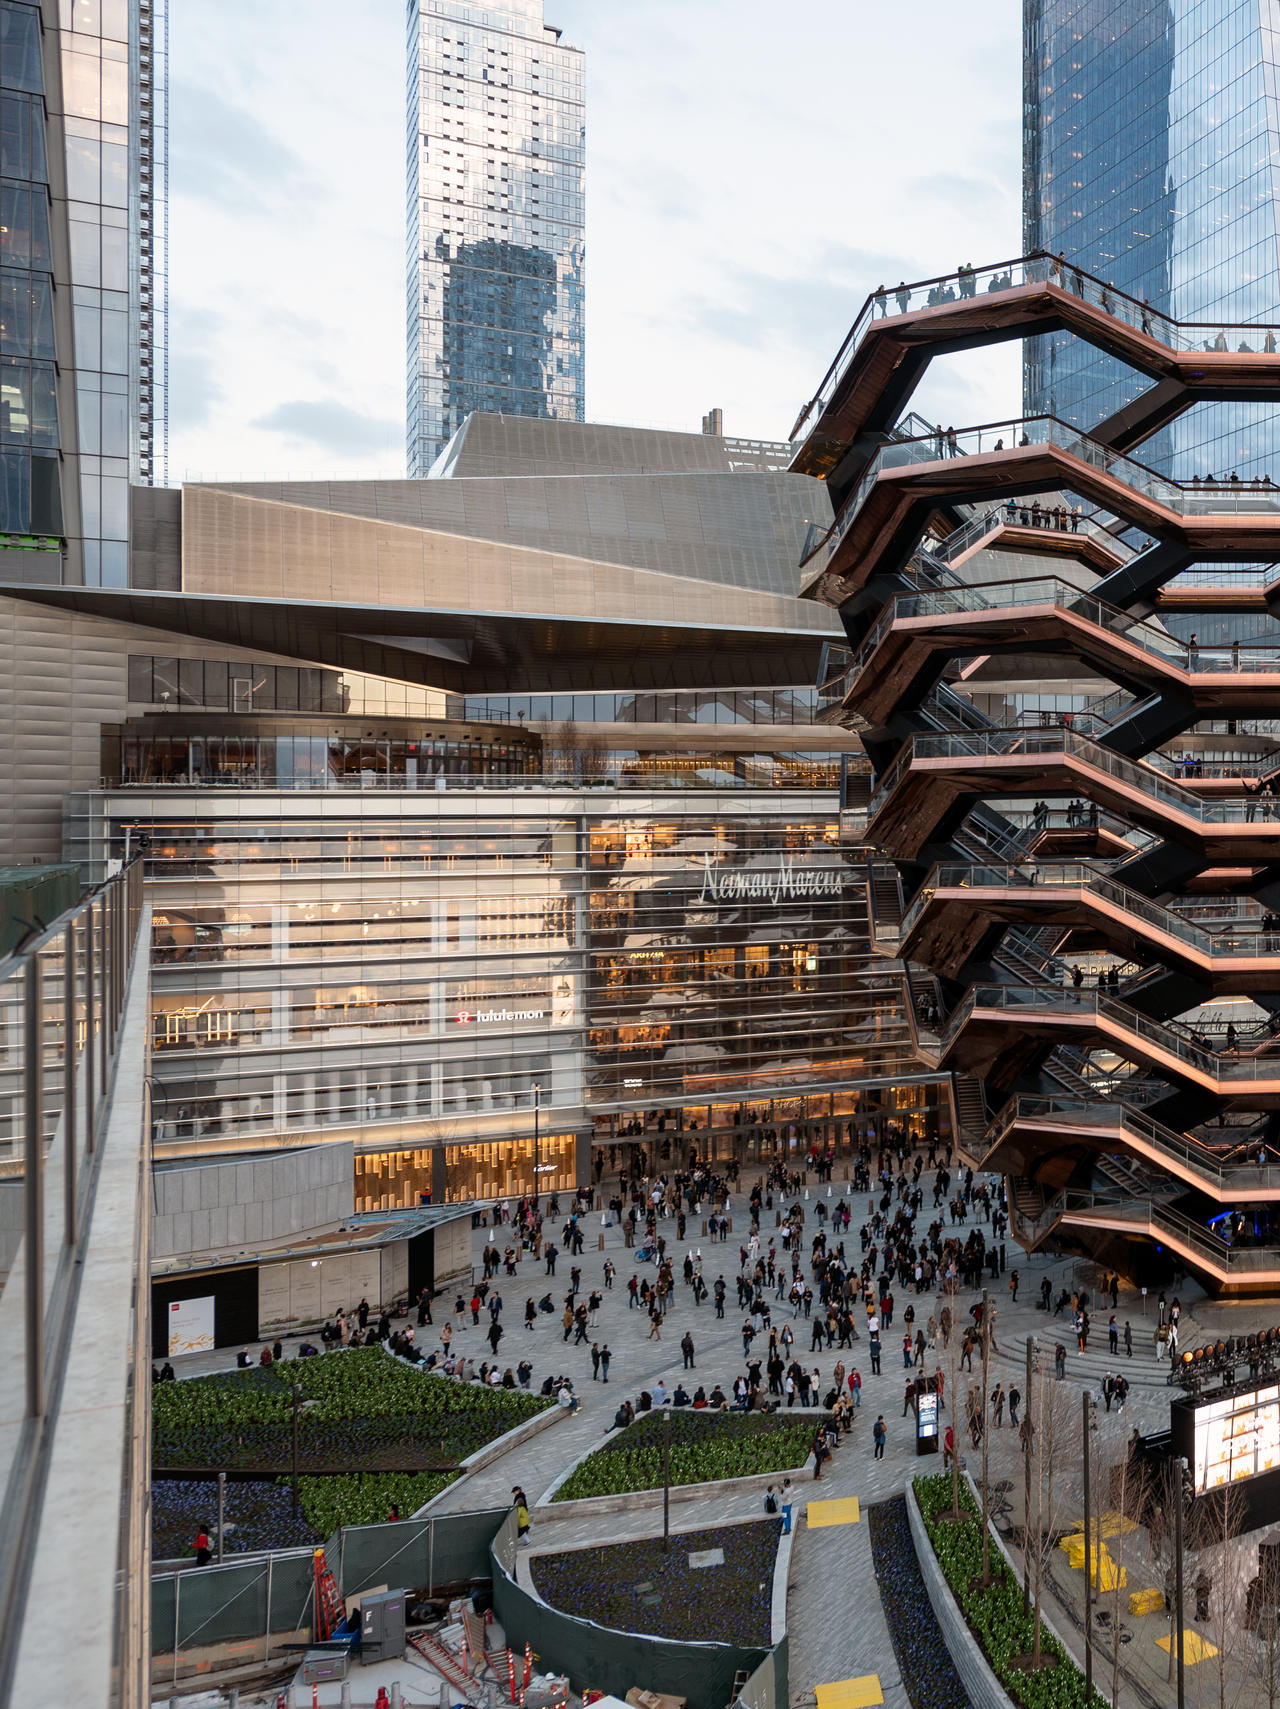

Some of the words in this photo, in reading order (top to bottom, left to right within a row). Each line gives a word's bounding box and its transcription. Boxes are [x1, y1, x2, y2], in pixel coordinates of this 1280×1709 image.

[698, 852, 772, 903] Neiman
[771, 852, 844, 907] Marcus
[477, 1008, 544, 1023] lululemon
